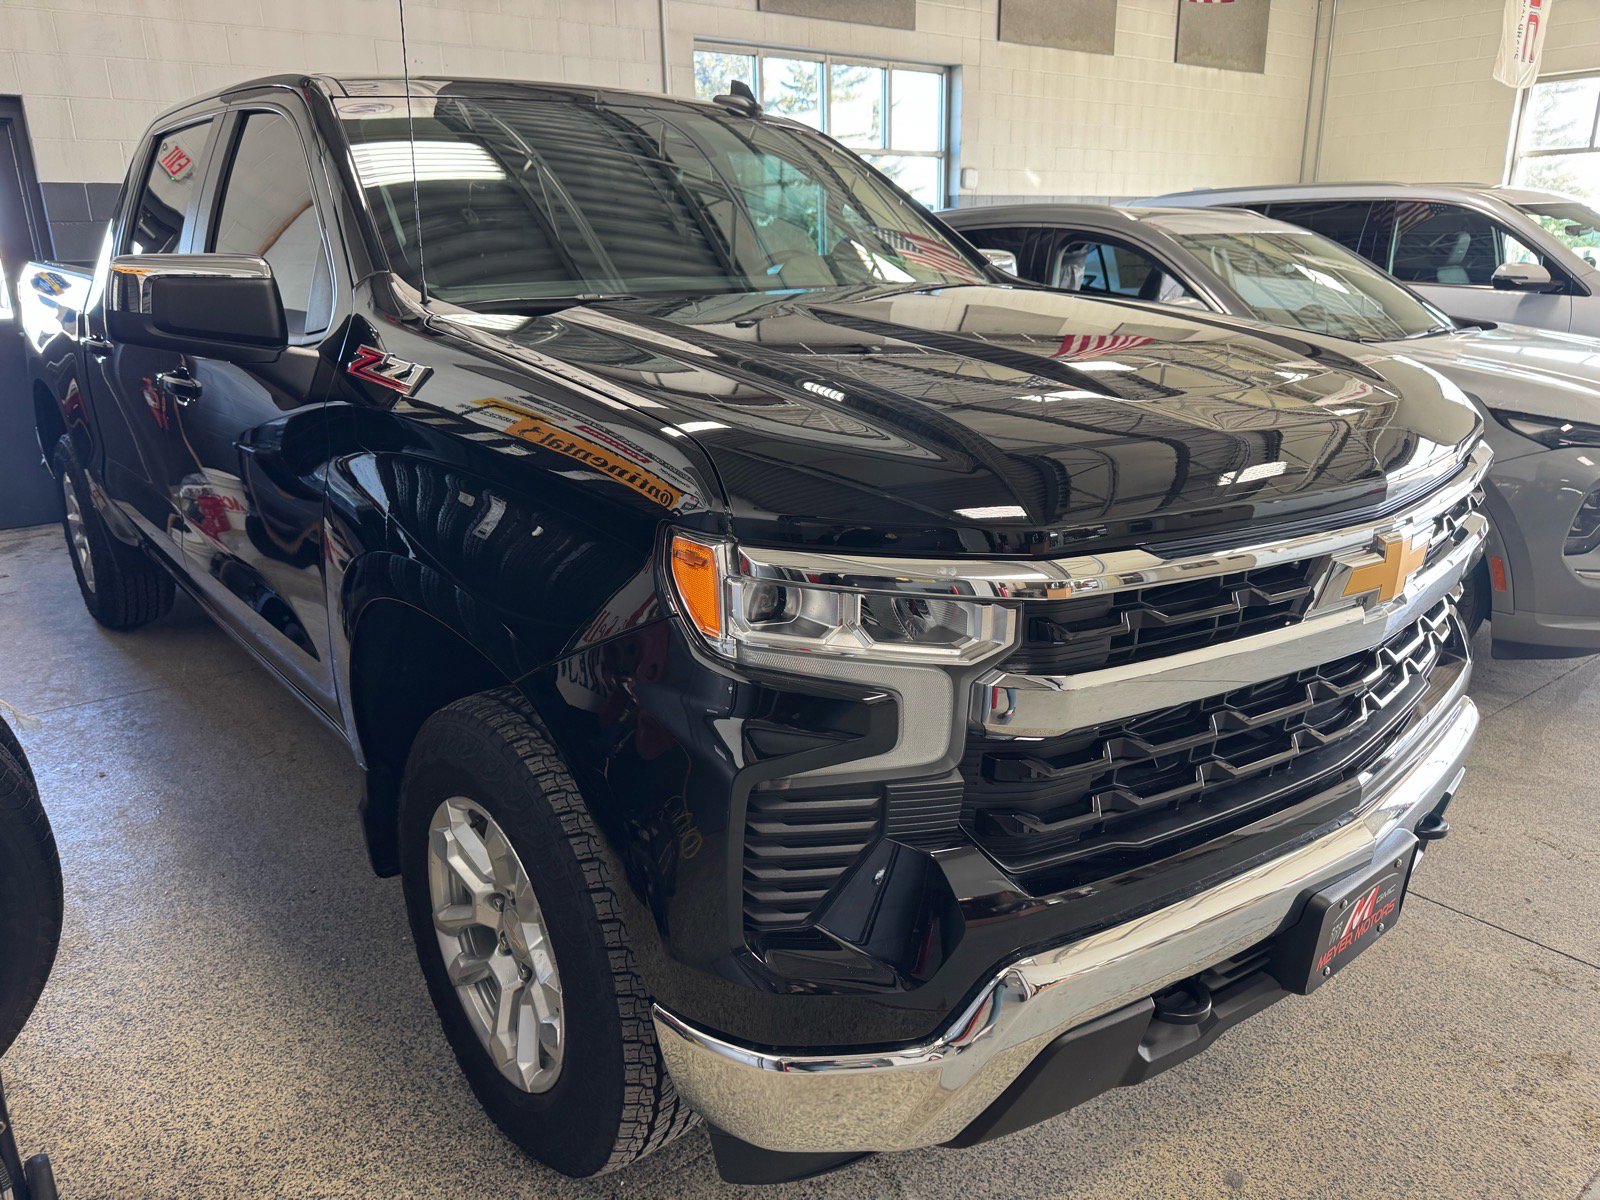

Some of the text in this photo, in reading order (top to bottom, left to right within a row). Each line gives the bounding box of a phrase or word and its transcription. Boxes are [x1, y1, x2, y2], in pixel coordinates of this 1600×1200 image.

[347, 344, 434, 397] Z71
[1315, 897, 1397, 972] MEYER MOTORS
